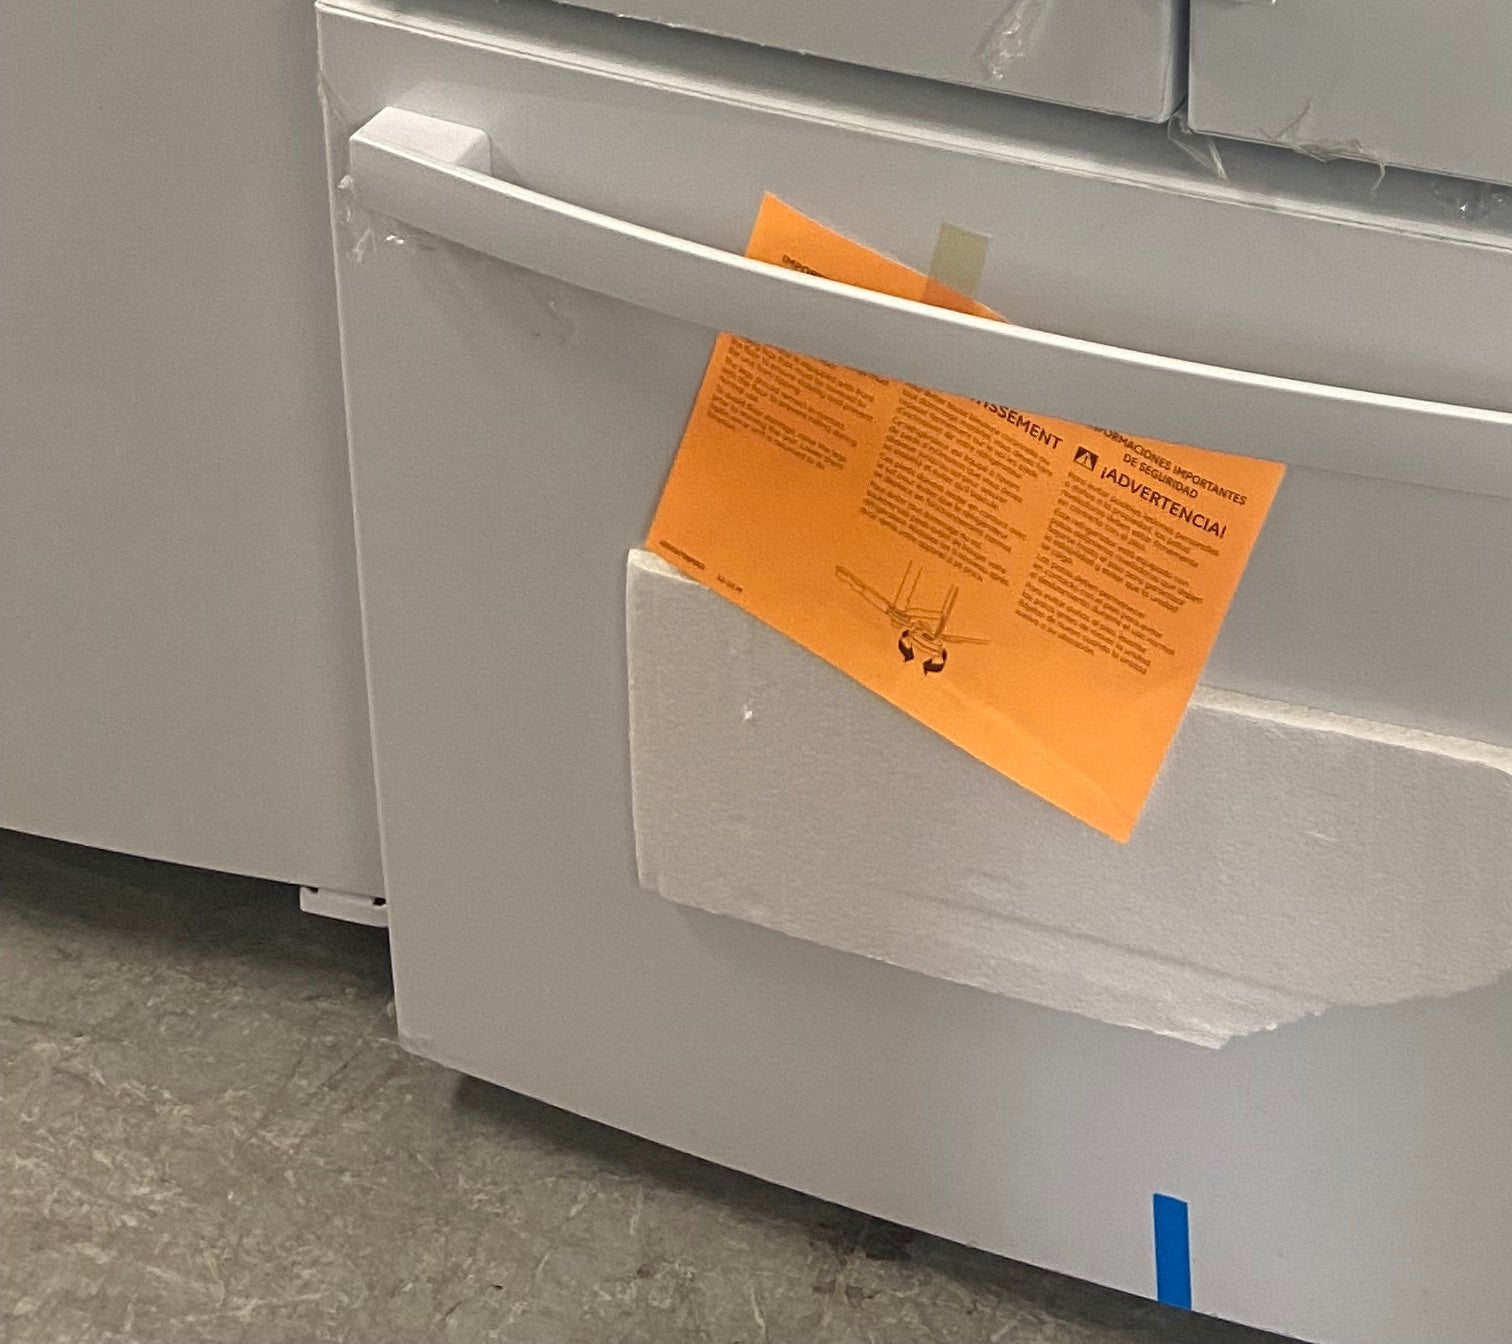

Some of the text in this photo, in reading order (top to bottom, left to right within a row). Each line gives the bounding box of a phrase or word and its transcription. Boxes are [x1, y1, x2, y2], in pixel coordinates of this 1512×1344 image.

[1123, 452, 1199, 499] DE SEGURIDAD
[1173, 464, 1248, 506] IMPORTANTES
[1100, 466, 1228, 540] ¡ADVERTENCIA!
